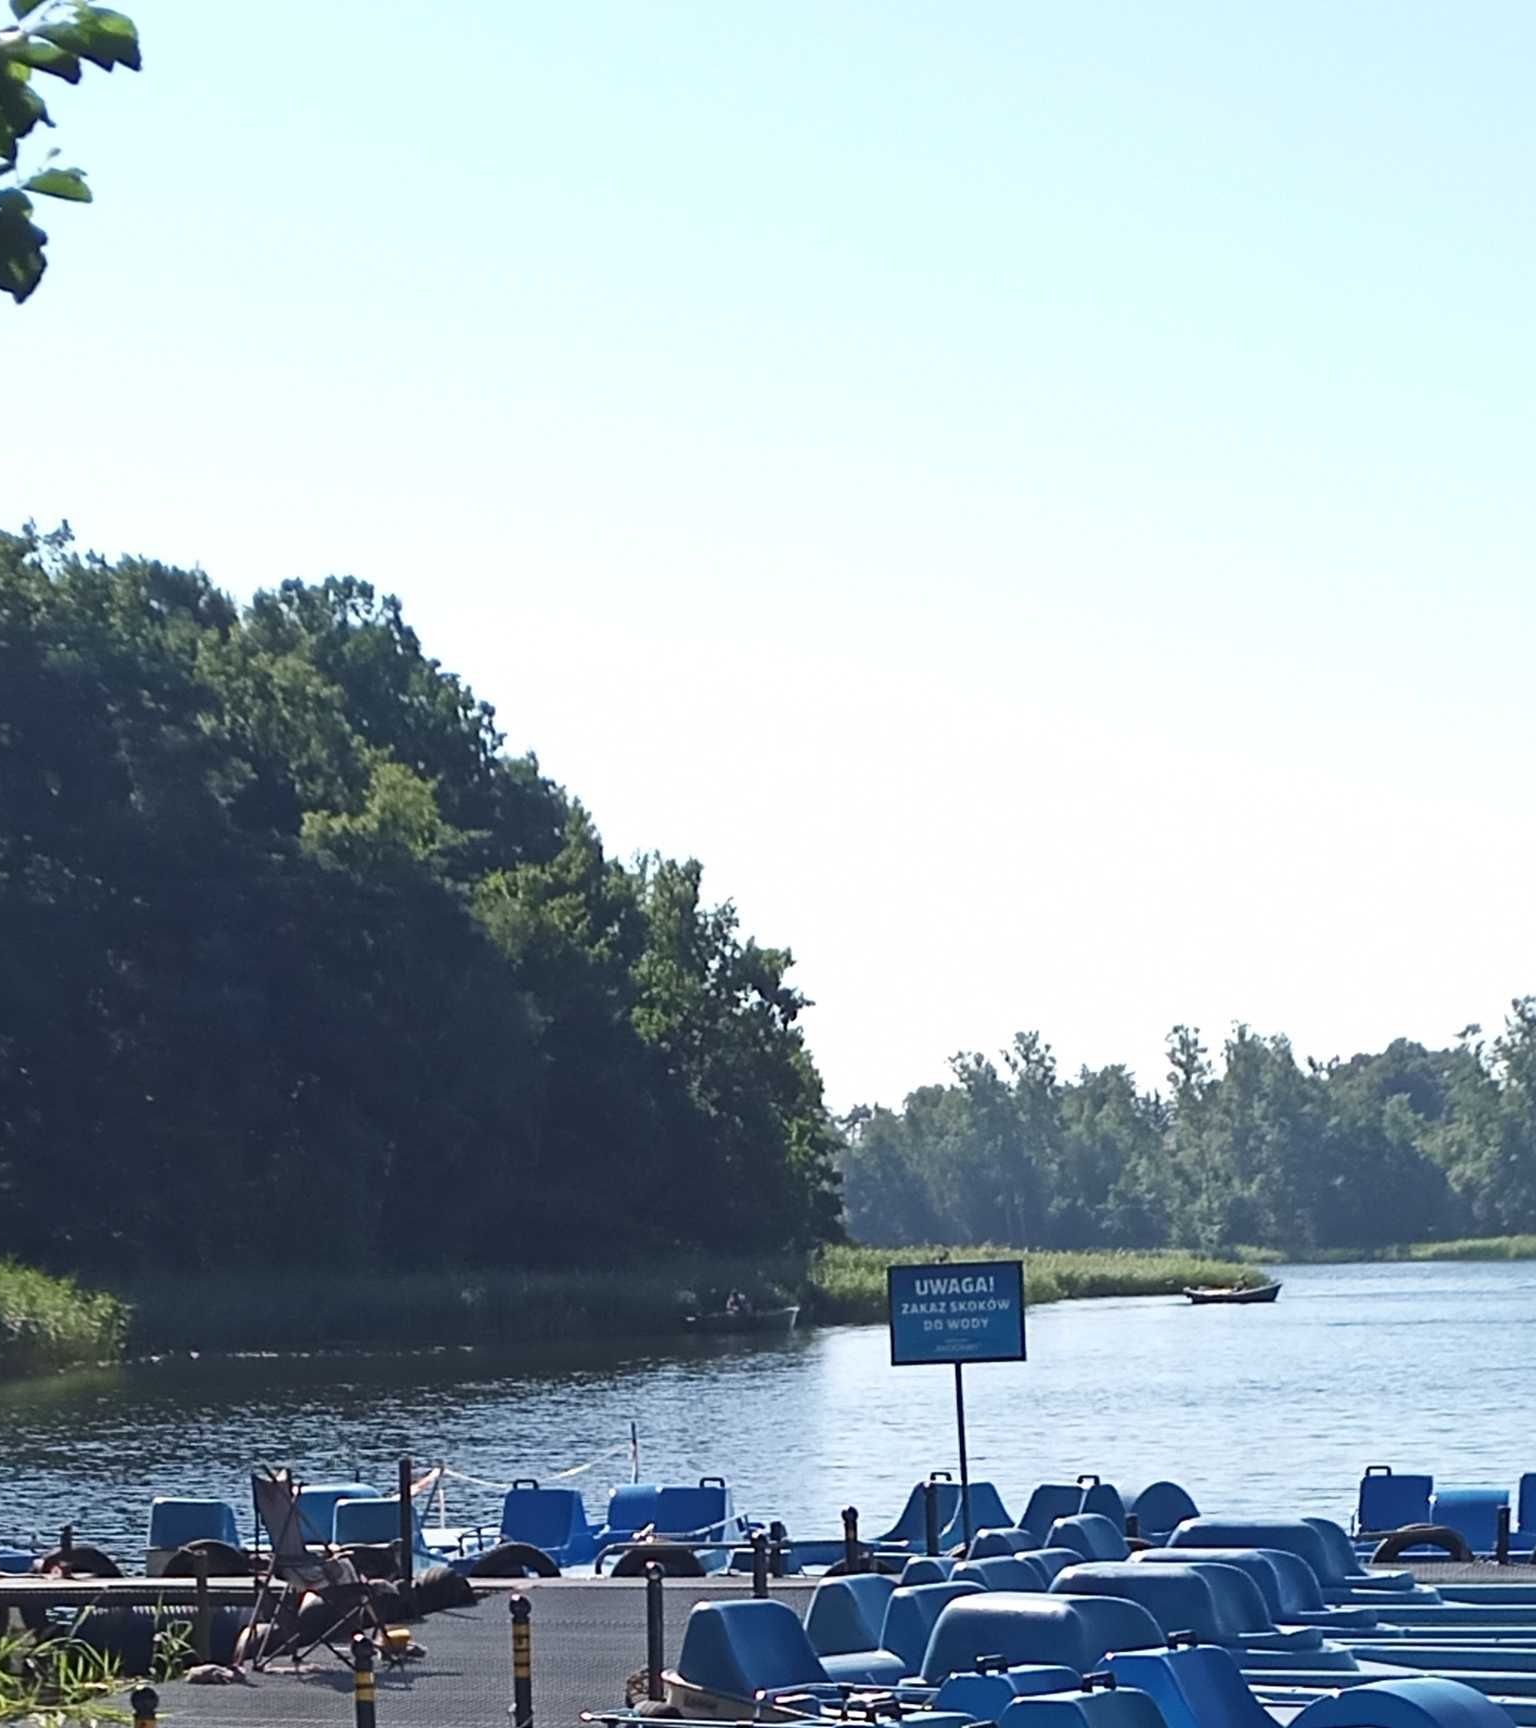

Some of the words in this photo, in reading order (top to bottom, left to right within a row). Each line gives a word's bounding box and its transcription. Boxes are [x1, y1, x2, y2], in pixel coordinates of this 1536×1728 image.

[915, 1276, 995, 1296] UWAGA!
[900, 1301, 947, 1315] ZAKAZ
[950, 1298, 1011, 1314] SKOKÓW
[923, 1318, 944, 1332] DO
[946, 1318, 989, 1330] WODY
